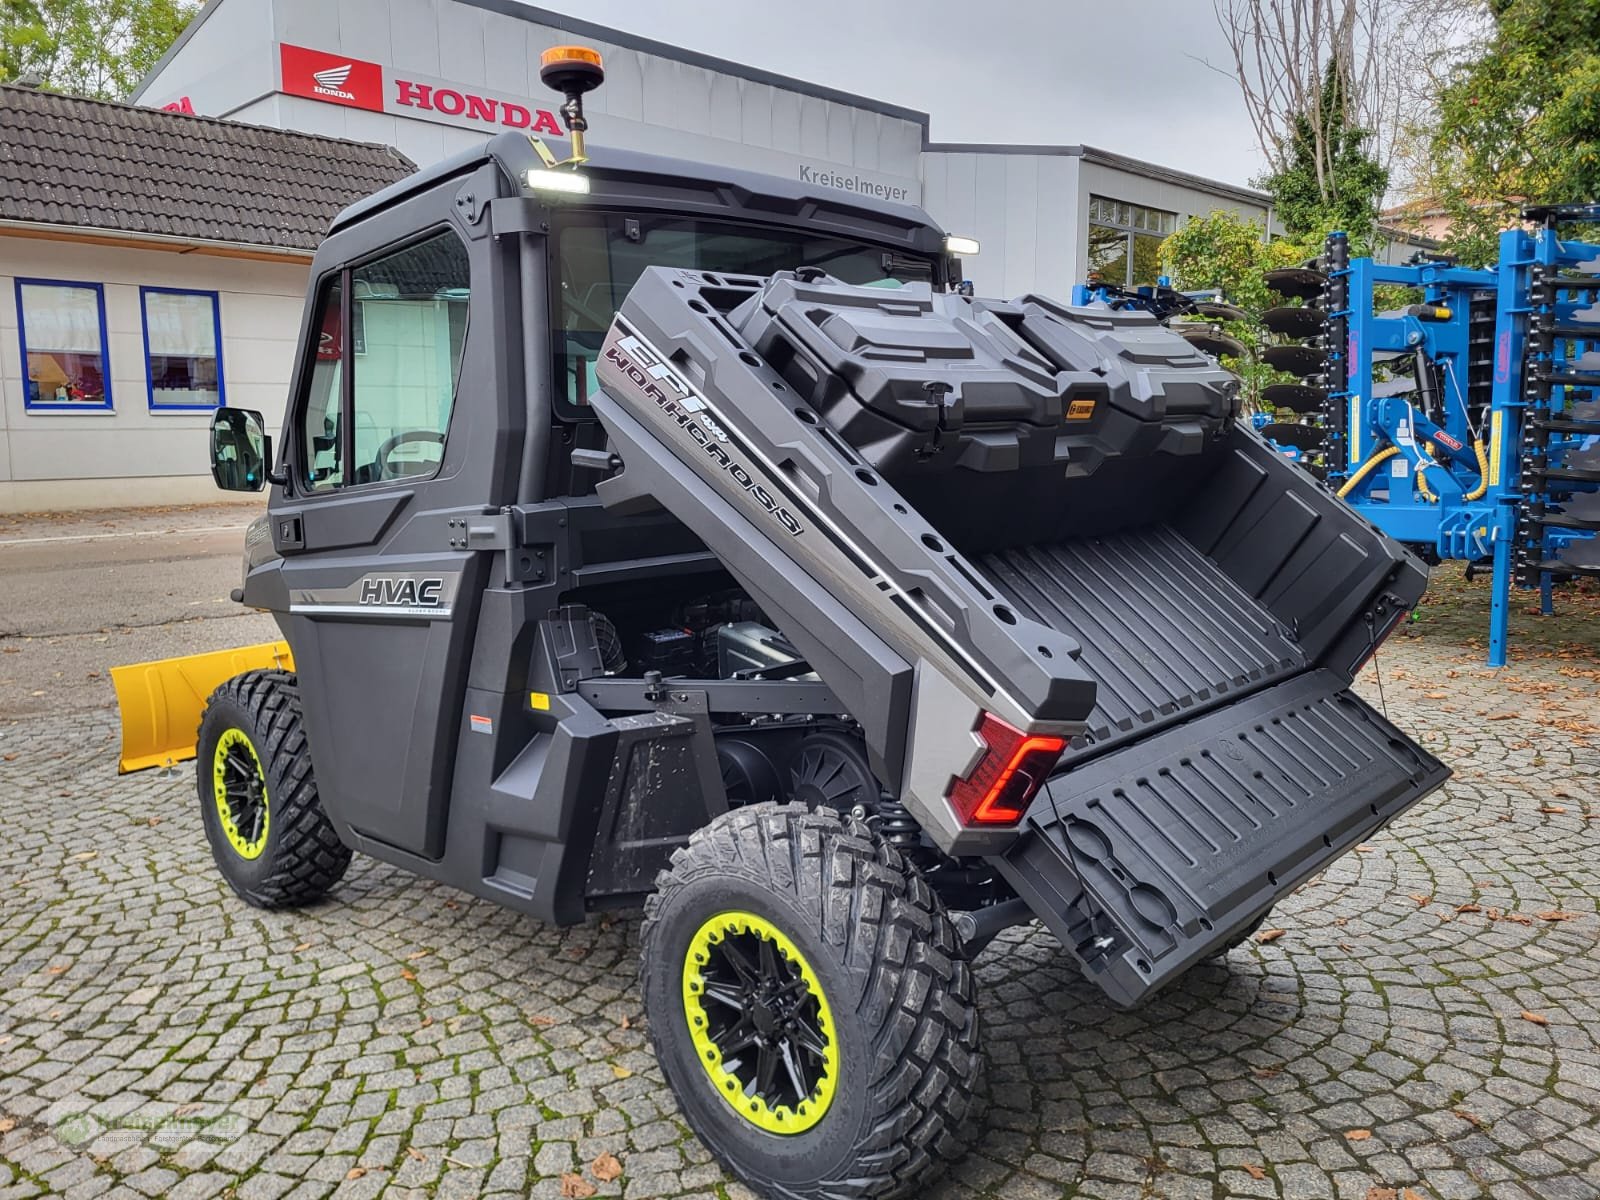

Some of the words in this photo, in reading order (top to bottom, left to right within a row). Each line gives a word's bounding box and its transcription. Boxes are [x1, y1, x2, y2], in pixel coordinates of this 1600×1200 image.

[314, 86, 355, 100] HONDA
[395, 79, 564, 137] HONDA
[799, 164, 908, 201] Kreiselmeyer
[604, 347, 804, 536] WORKCROSS
[360, 578, 443, 606] HVAC
